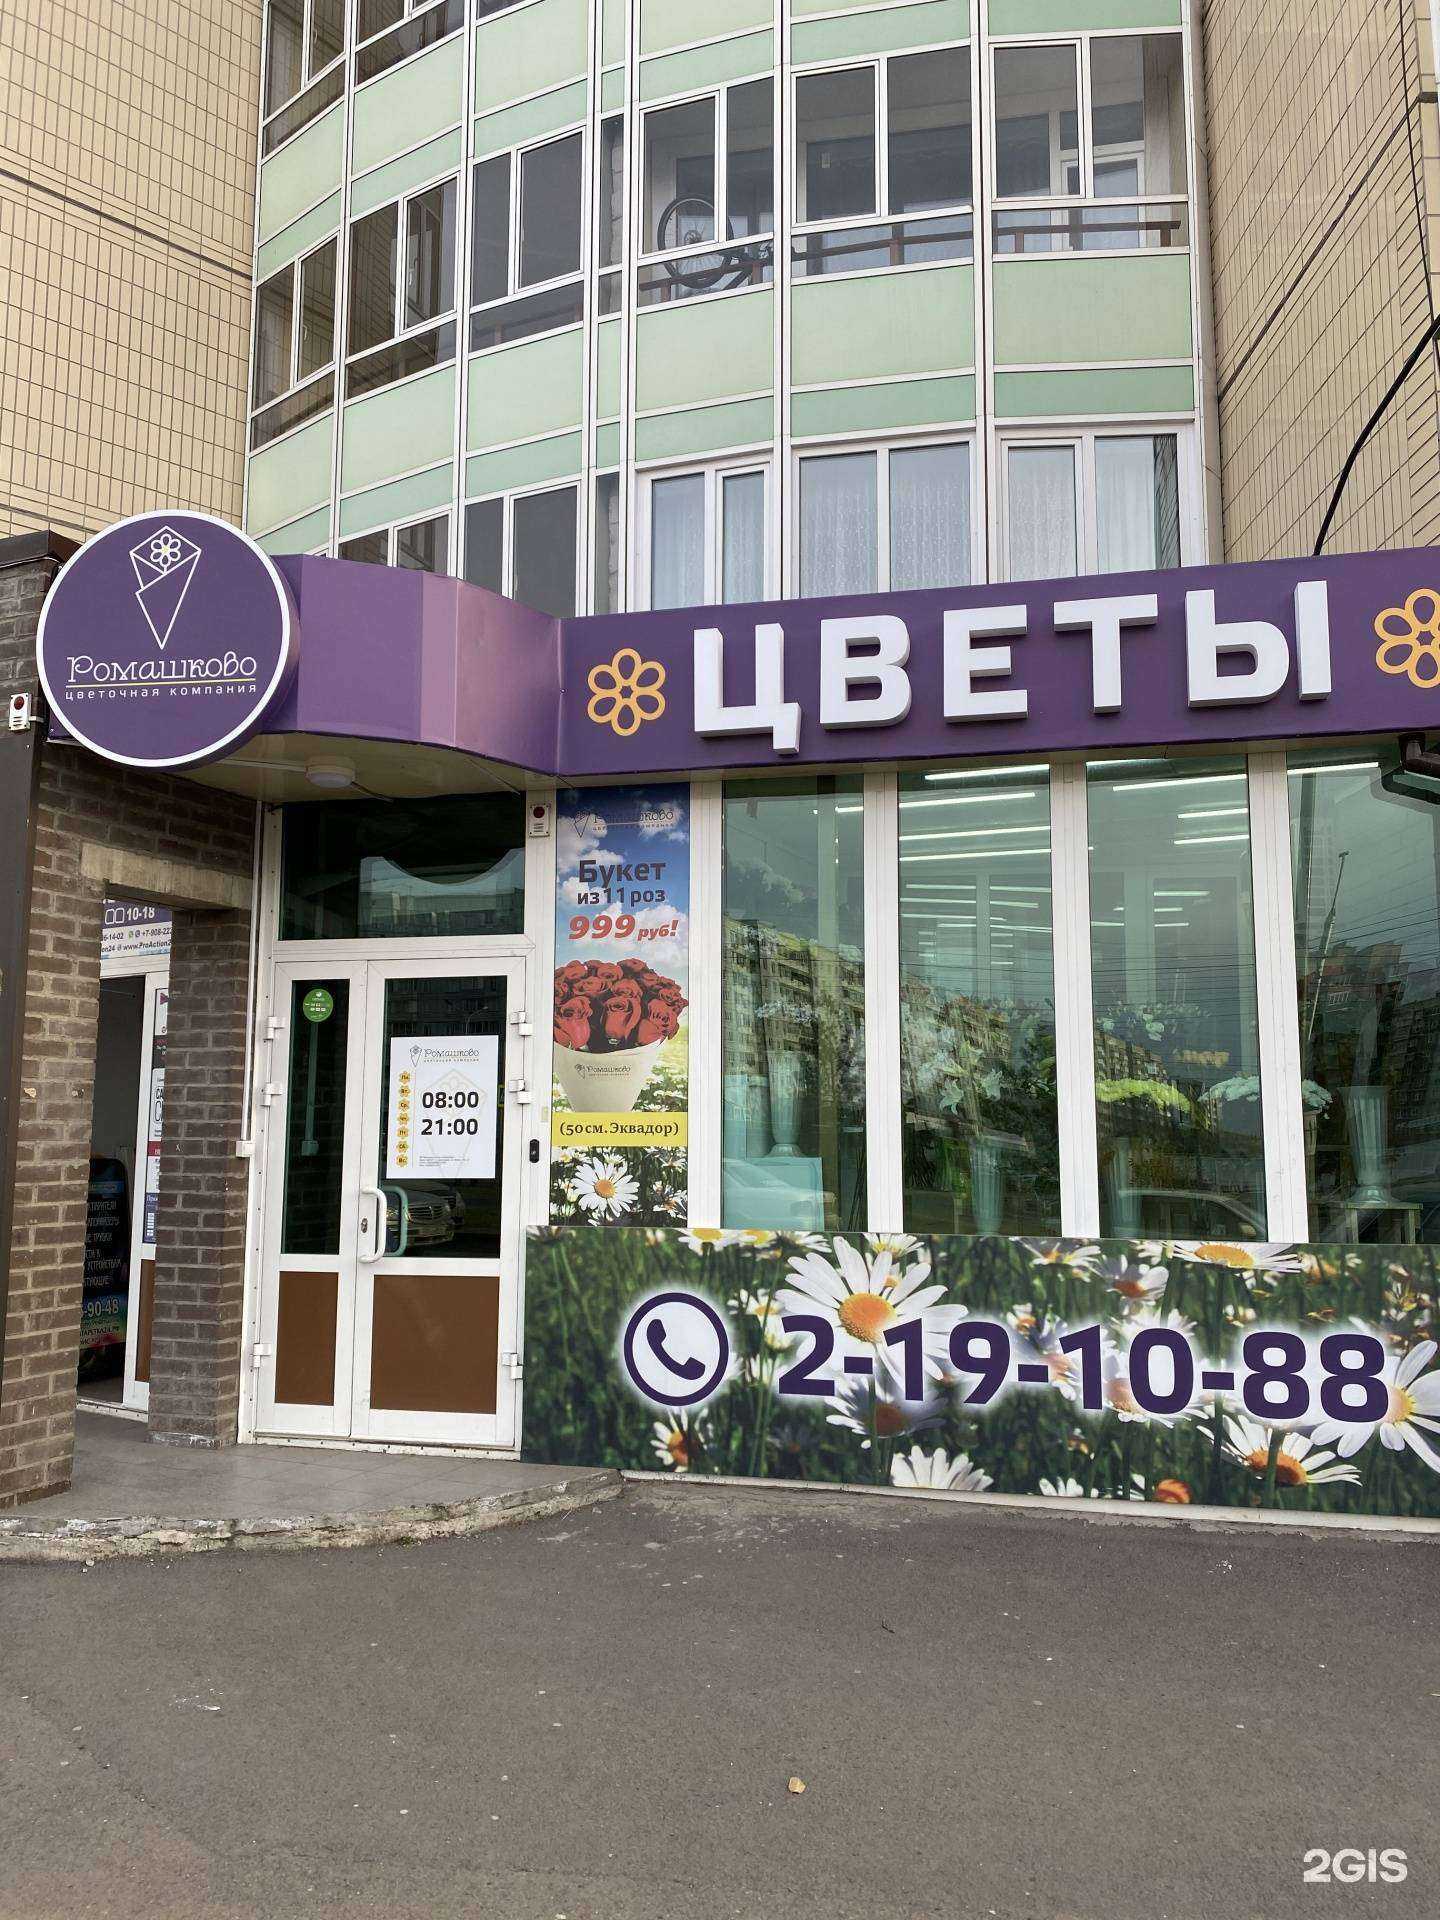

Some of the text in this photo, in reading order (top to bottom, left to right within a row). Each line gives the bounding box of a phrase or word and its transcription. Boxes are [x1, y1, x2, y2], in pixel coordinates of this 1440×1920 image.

[66, 650, 257, 683] Ромашково
[693, 579, 1332, 755] ЦВЕТЫ
[65, 684, 257, 701] цветочная компания
[578, 859, 667, 888] Букет
[577, 886, 666, 907] из 11 роз
[126, 905, 155, 921] 10-18
[568, 914, 680, 942] 999 руб!
[424, 1047, 480, 1058] Ромашково
[422, 1092, 479, 1108] 08:00
[421, 1119, 478, 1135] 21:00
[777, 1313, 1390, 1424] 2-19-10-88
